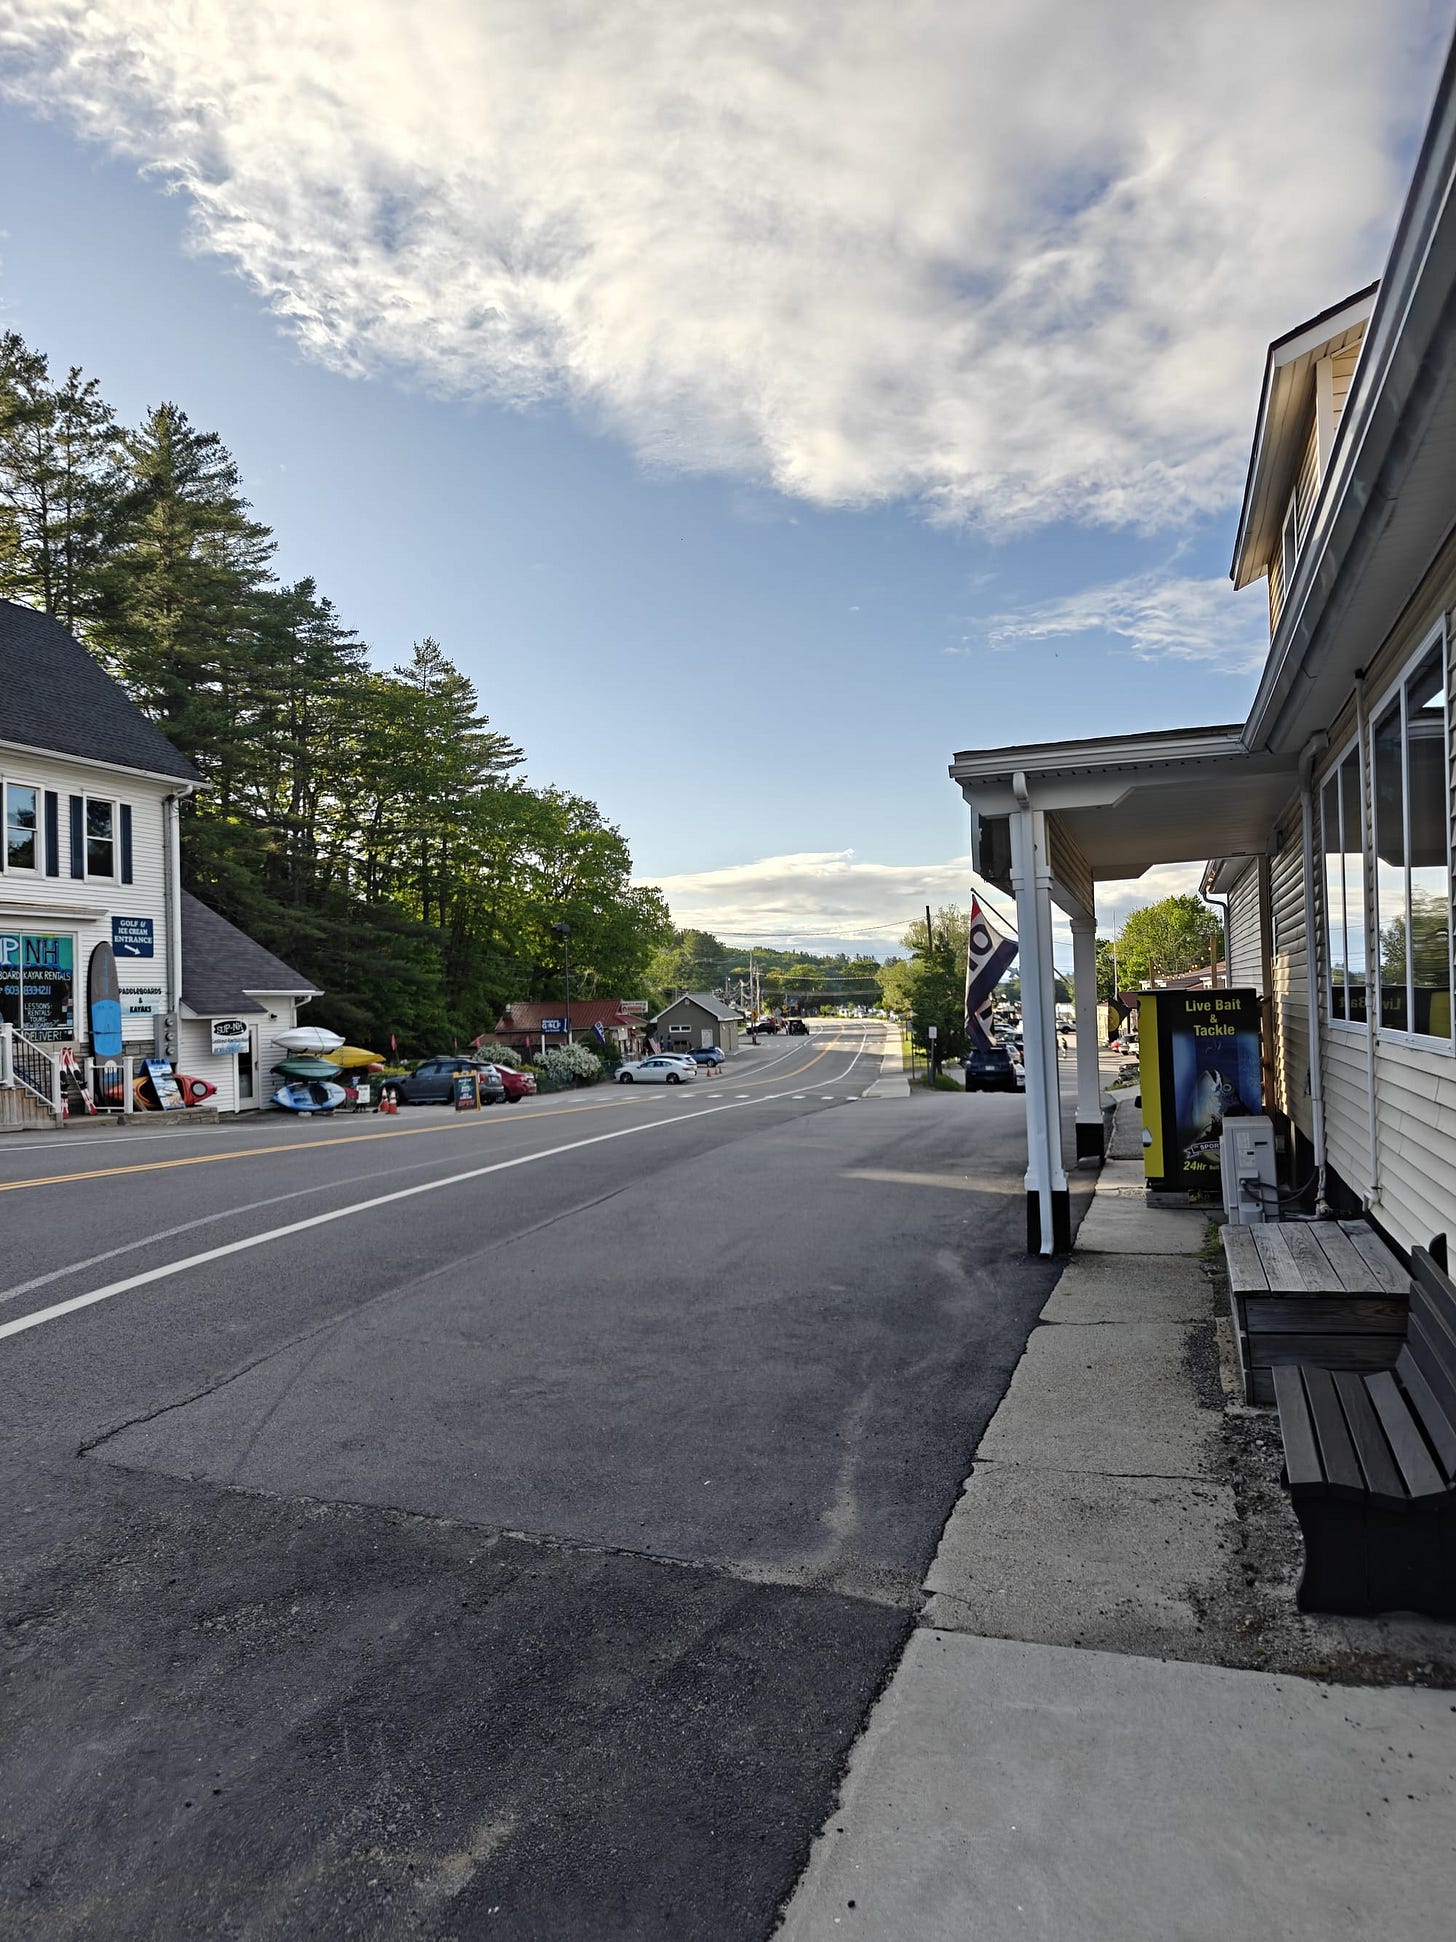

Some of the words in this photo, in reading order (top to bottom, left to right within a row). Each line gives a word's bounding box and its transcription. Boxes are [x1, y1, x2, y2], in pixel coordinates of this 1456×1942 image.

[120, 919, 138, 928] GOLF
[140, 920, 146, 928] &
[118, 927, 128, 935] ICE
[128, 928, 148, 936] CREAM
[114, 935, 153, 944] ENTRANCE
[25, 938, 59, 966] NH
[22, 970, 44, 980] KAYAK
[4, 984, 20, 996] 603
[118, 987, 161, 995] PADDLEBOARDS
[138, 996, 143, 1004] &
[1185, 1000, 1211, 1012] Live
[1215, 998, 1242, 1011] Bait
[1209, 1014, 1218, 1024] &
[1194, 1024, 1235, 1036] Tackle
[1183, 1160, 1207, 1171] 24Hr
